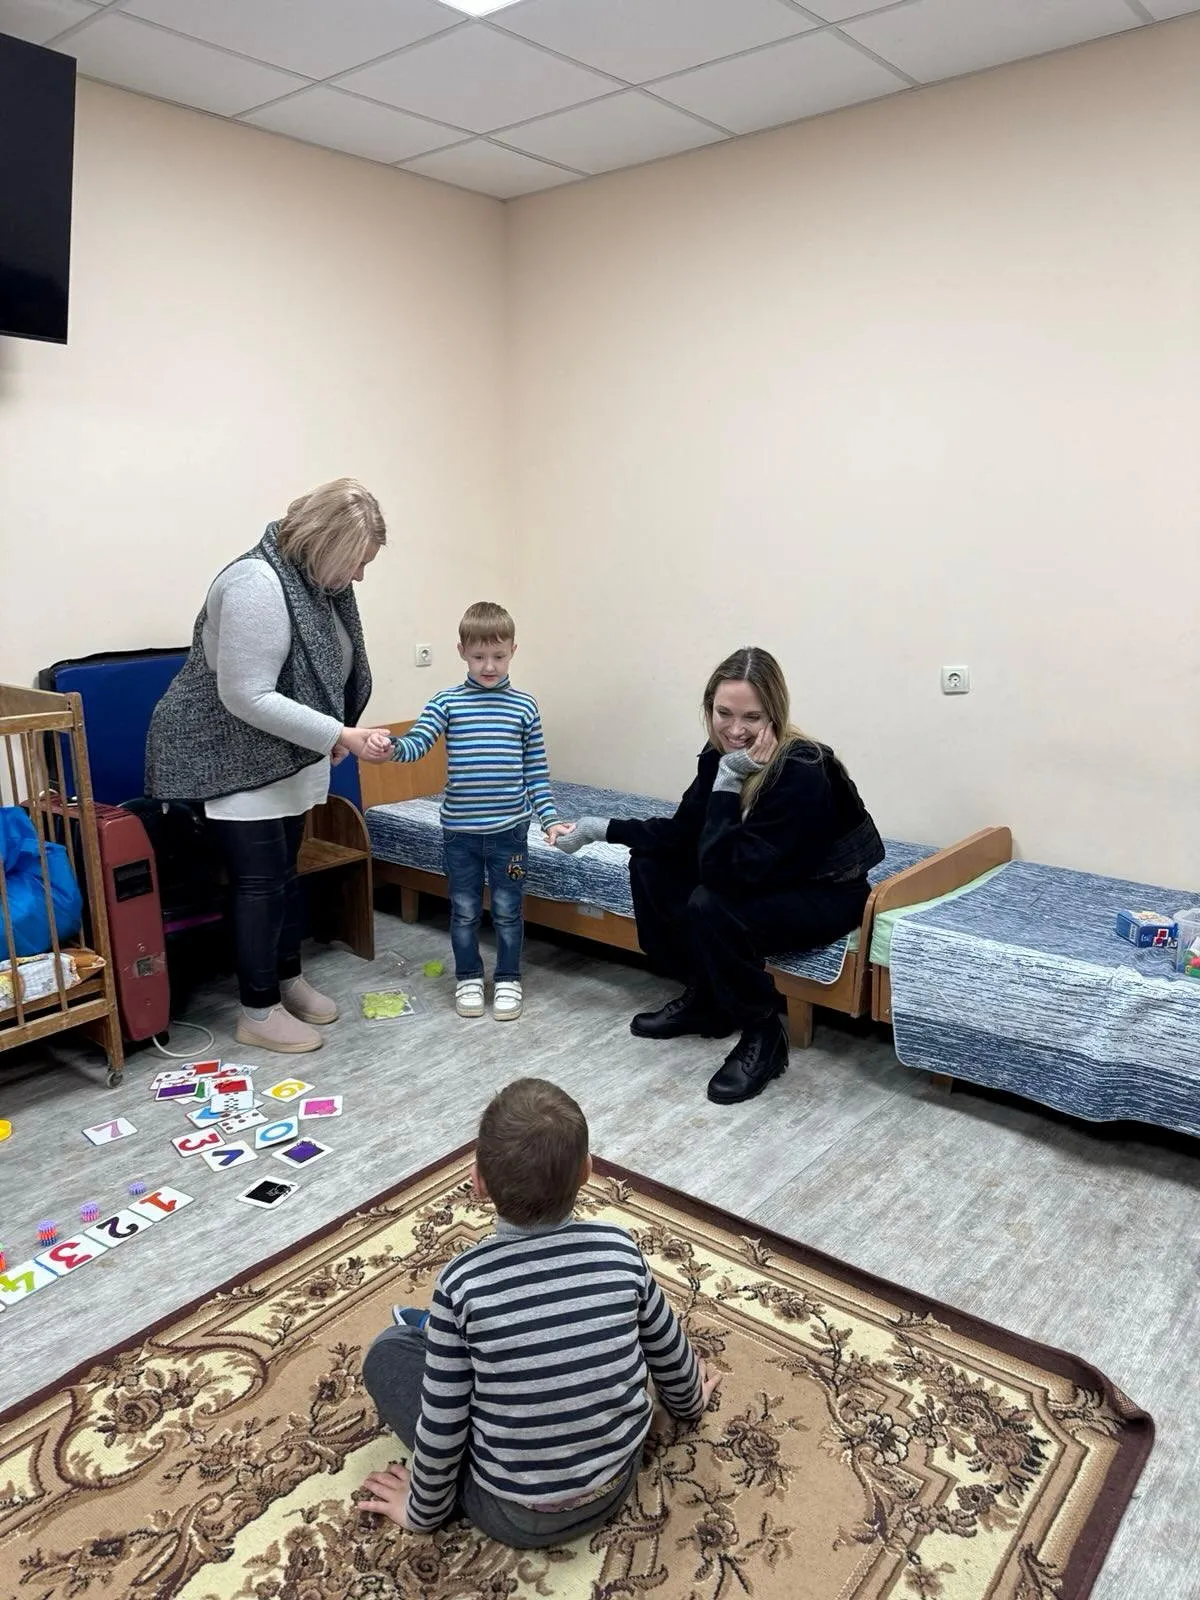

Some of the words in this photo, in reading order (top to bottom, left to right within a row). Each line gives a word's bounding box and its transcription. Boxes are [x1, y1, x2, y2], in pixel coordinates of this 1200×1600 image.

[94, 1120, 122, 1139] 7
[177, 1133, 220, 1152] 3
[139, 1191, 177, 1213] 1
[96, 1216, 139, 1239] 2
[49, 1242, 93, 1269] 3
[0, 1270, 35, 1293] 4
